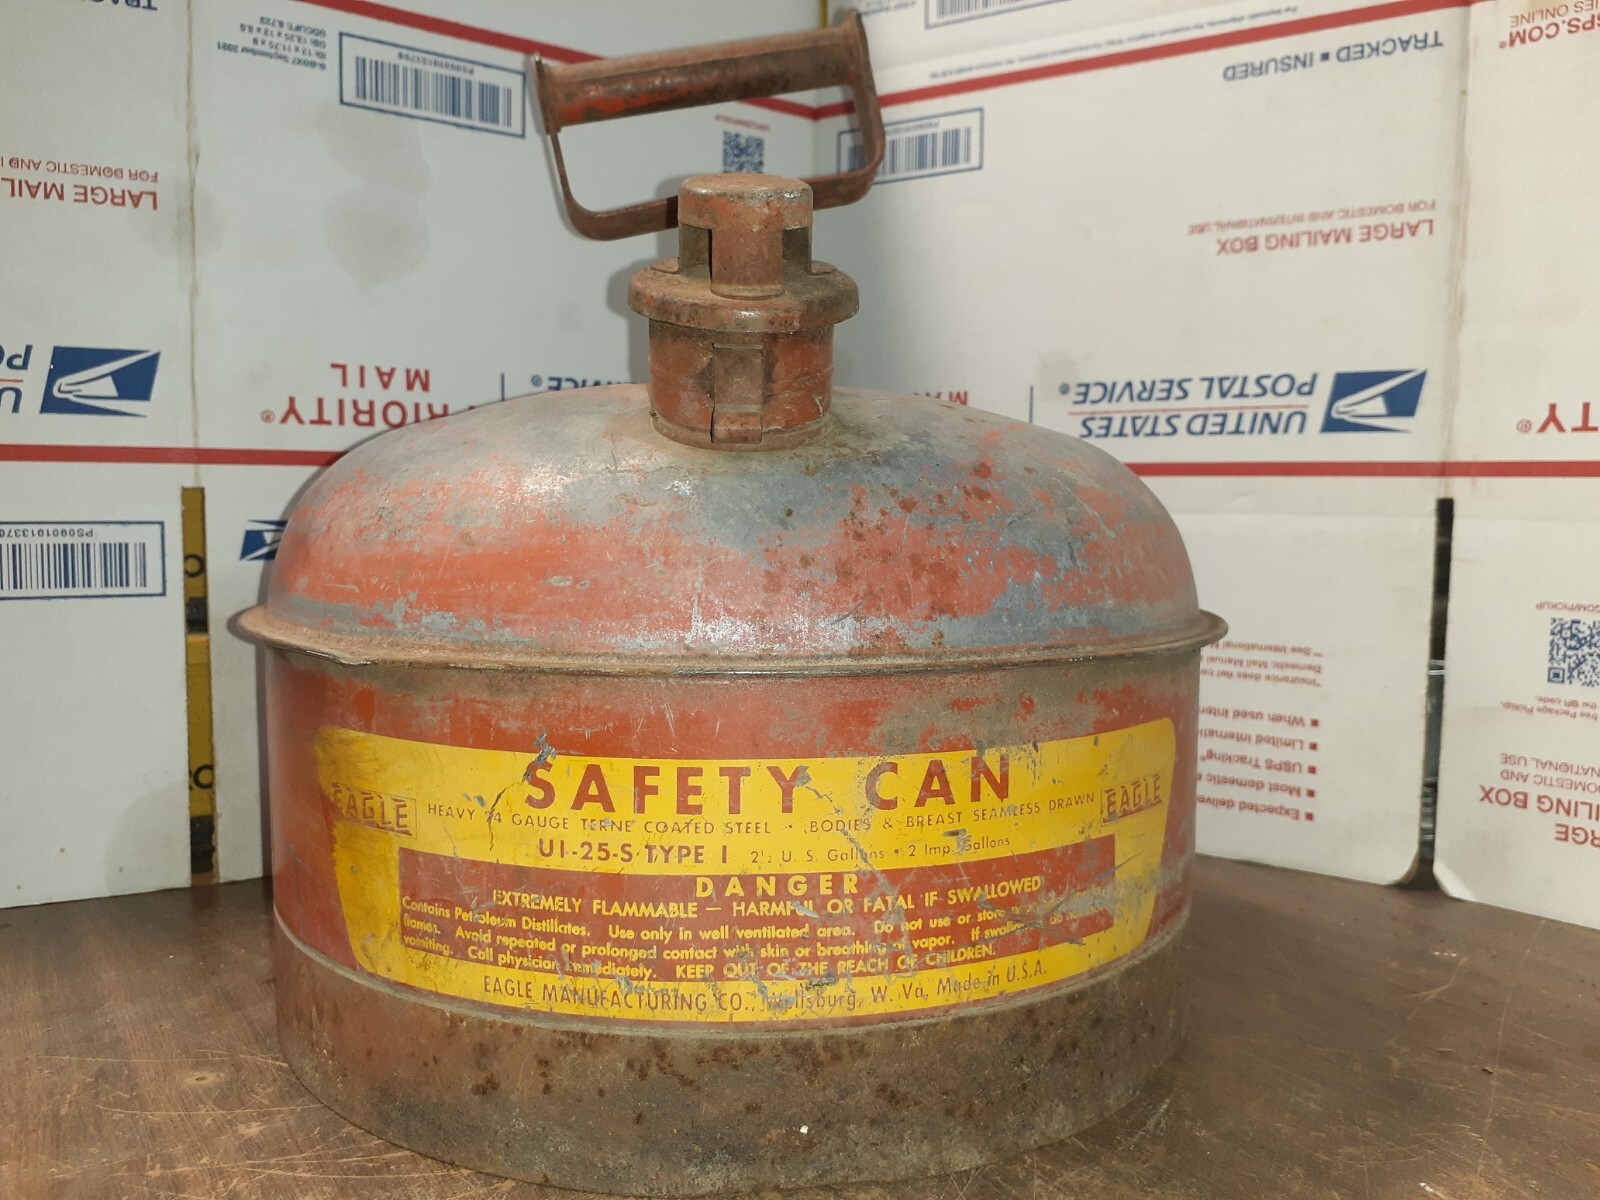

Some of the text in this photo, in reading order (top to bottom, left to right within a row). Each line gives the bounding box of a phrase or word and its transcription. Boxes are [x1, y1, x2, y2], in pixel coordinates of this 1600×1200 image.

[1510, 4, 1568, 28] ONLINE
[1223, 30, 1444, 82] TRACKED INSURED
[8, 157, 159, 183] FOR DOMESTIC AND
[0, 177, 158, 211] LARGE MAIL
[1216, 219, 1434, 255] LARGE MAILING BOX
[330, 363, 431, 392] MAIL
[1199, 372, 1318, 399] POSTAL
[1079, 411, 1308, 438] UNITED STATES
[1233, 708, 1264, 720] used
[1268, 713, 1306, 727] When
[1536, 706, 1576, 719] Package
[1255, 734, 1304, 751] Limited
[1264, 759, 1302, 773] USPS
[1499, 753, 1527, 767] USE
[524, 755, 1010, 815] SAFETY CAN
[1206, 773, 1265, 791] domestic
[1268, 782, 1301, 797] Most
[1500, 769, 1600, 794] OMESTIC AND
[332, 783, 409, 831] EAGLE
[1105, 774, 1162, 818] EAGLE
[1479, 784, 1528, 810] BOX
[428, 803, 475, 821] HEAVY
[512, 813, 569, 829] GAUGE
[581, 818, 632, 833] TERNE
[644, 820, 715, 834] COATED
[725, 821, 771, 834] STEEL
[810, 818, 871, 833] BODIES
[883, 818, 892, 829] &
[906, 812, 963, 828] BREAST
[973, 802, 1040, 821] SEAMLESS
[1049, 792, 1095, 812] DRAWN
[1238, 800, 1300, 821] Expected
[645, 844, 705, 863] TYPE
[909, 845, 916, 857] 2
[493, 889, 582, 913] EXTREMELY
[593, 900, 698, 918] FLAMMABLE
[732, 900, 814, 918] HARMFUL
[827, 898, 854, 914] OR
[864, 894, 914, 912] FATAL
[925, 892, 938, 907] IF
[947, 875, 1042, 905] SWALLOWED
[696, 873, 858, 898] DANGER
[403, 896, 450, 917] Contains
[455, 906, 516, 928] Petroleum
[522, 916, 591, 937] Distillates.
[609, 924, 635, 939] Use
[640, 926, 672, 944] only
[679, 927, 692, 940] in
[699, 925, 729, 940] well
[736, 924, 811, 939] ventilated
[817, 926, 855, 938] area.
[874, 920, 893, 935] Do
[930, 916, 950, 928] use
[957, 915, 971, 925] or
[456, 925, 492, 944] Avoid
[496, 934, 556, 952] repeated
[561, 943, 577, 953] or
[582, 942, 657, 961] prolonged
[663, 946, 718, 960] contact
[724, 944, 754, 958] with
[760, 943, 788, 958] skin
[795, 947, 811, 958] or
[912, 937, 955, 951] vapor.
[972, 928, 980, 941] If
[404, 934, 453, 956] vomiting.
[468, 946, 493, 961] Call
[498, 953, 557, 971] physician
[676, 964, 715, 979] KEEP
[724, 963, 757, 977] OUT
[767, 962, 789, 976] OF
[798, 961, 828, 976] THE
[837, 958, 889, 974] REACH
[897, 955, 915, 969] OF
[926, 944, 996, 966] CHILDREN.
[484, 975, 533, 999] EAGLE
[543, 983, 707, 1011] MANUFACTURING
[871, 985, 893, 1003] W.
[902, 981, 929, 1000] Va.
[937, 972, 980, 996] Made
[987, 966, 999, 988] in
[1007, 960, 1046, 982] U.S.A.
